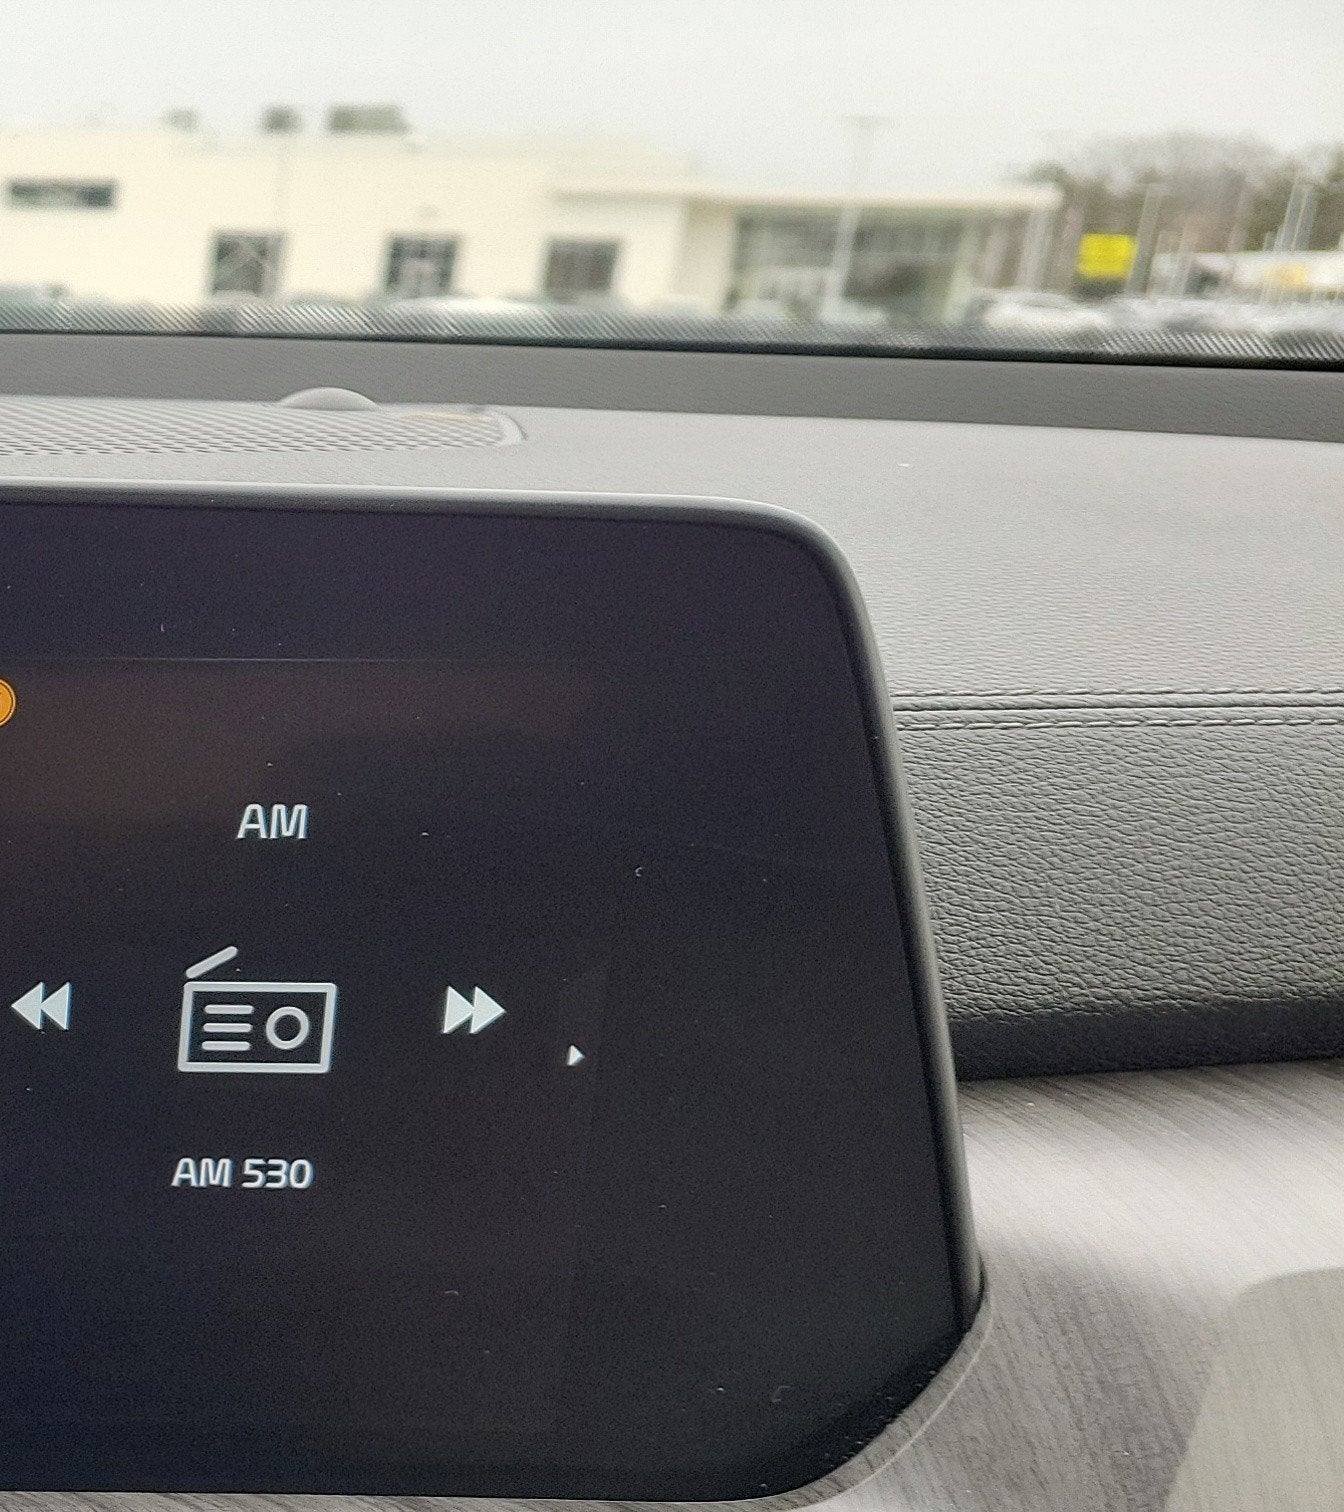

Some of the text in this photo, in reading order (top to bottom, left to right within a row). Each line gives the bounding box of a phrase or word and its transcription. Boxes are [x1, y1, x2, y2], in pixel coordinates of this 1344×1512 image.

[237, 803, 309, 840] AM
[172, 1158, 314, 1190] AM 530
